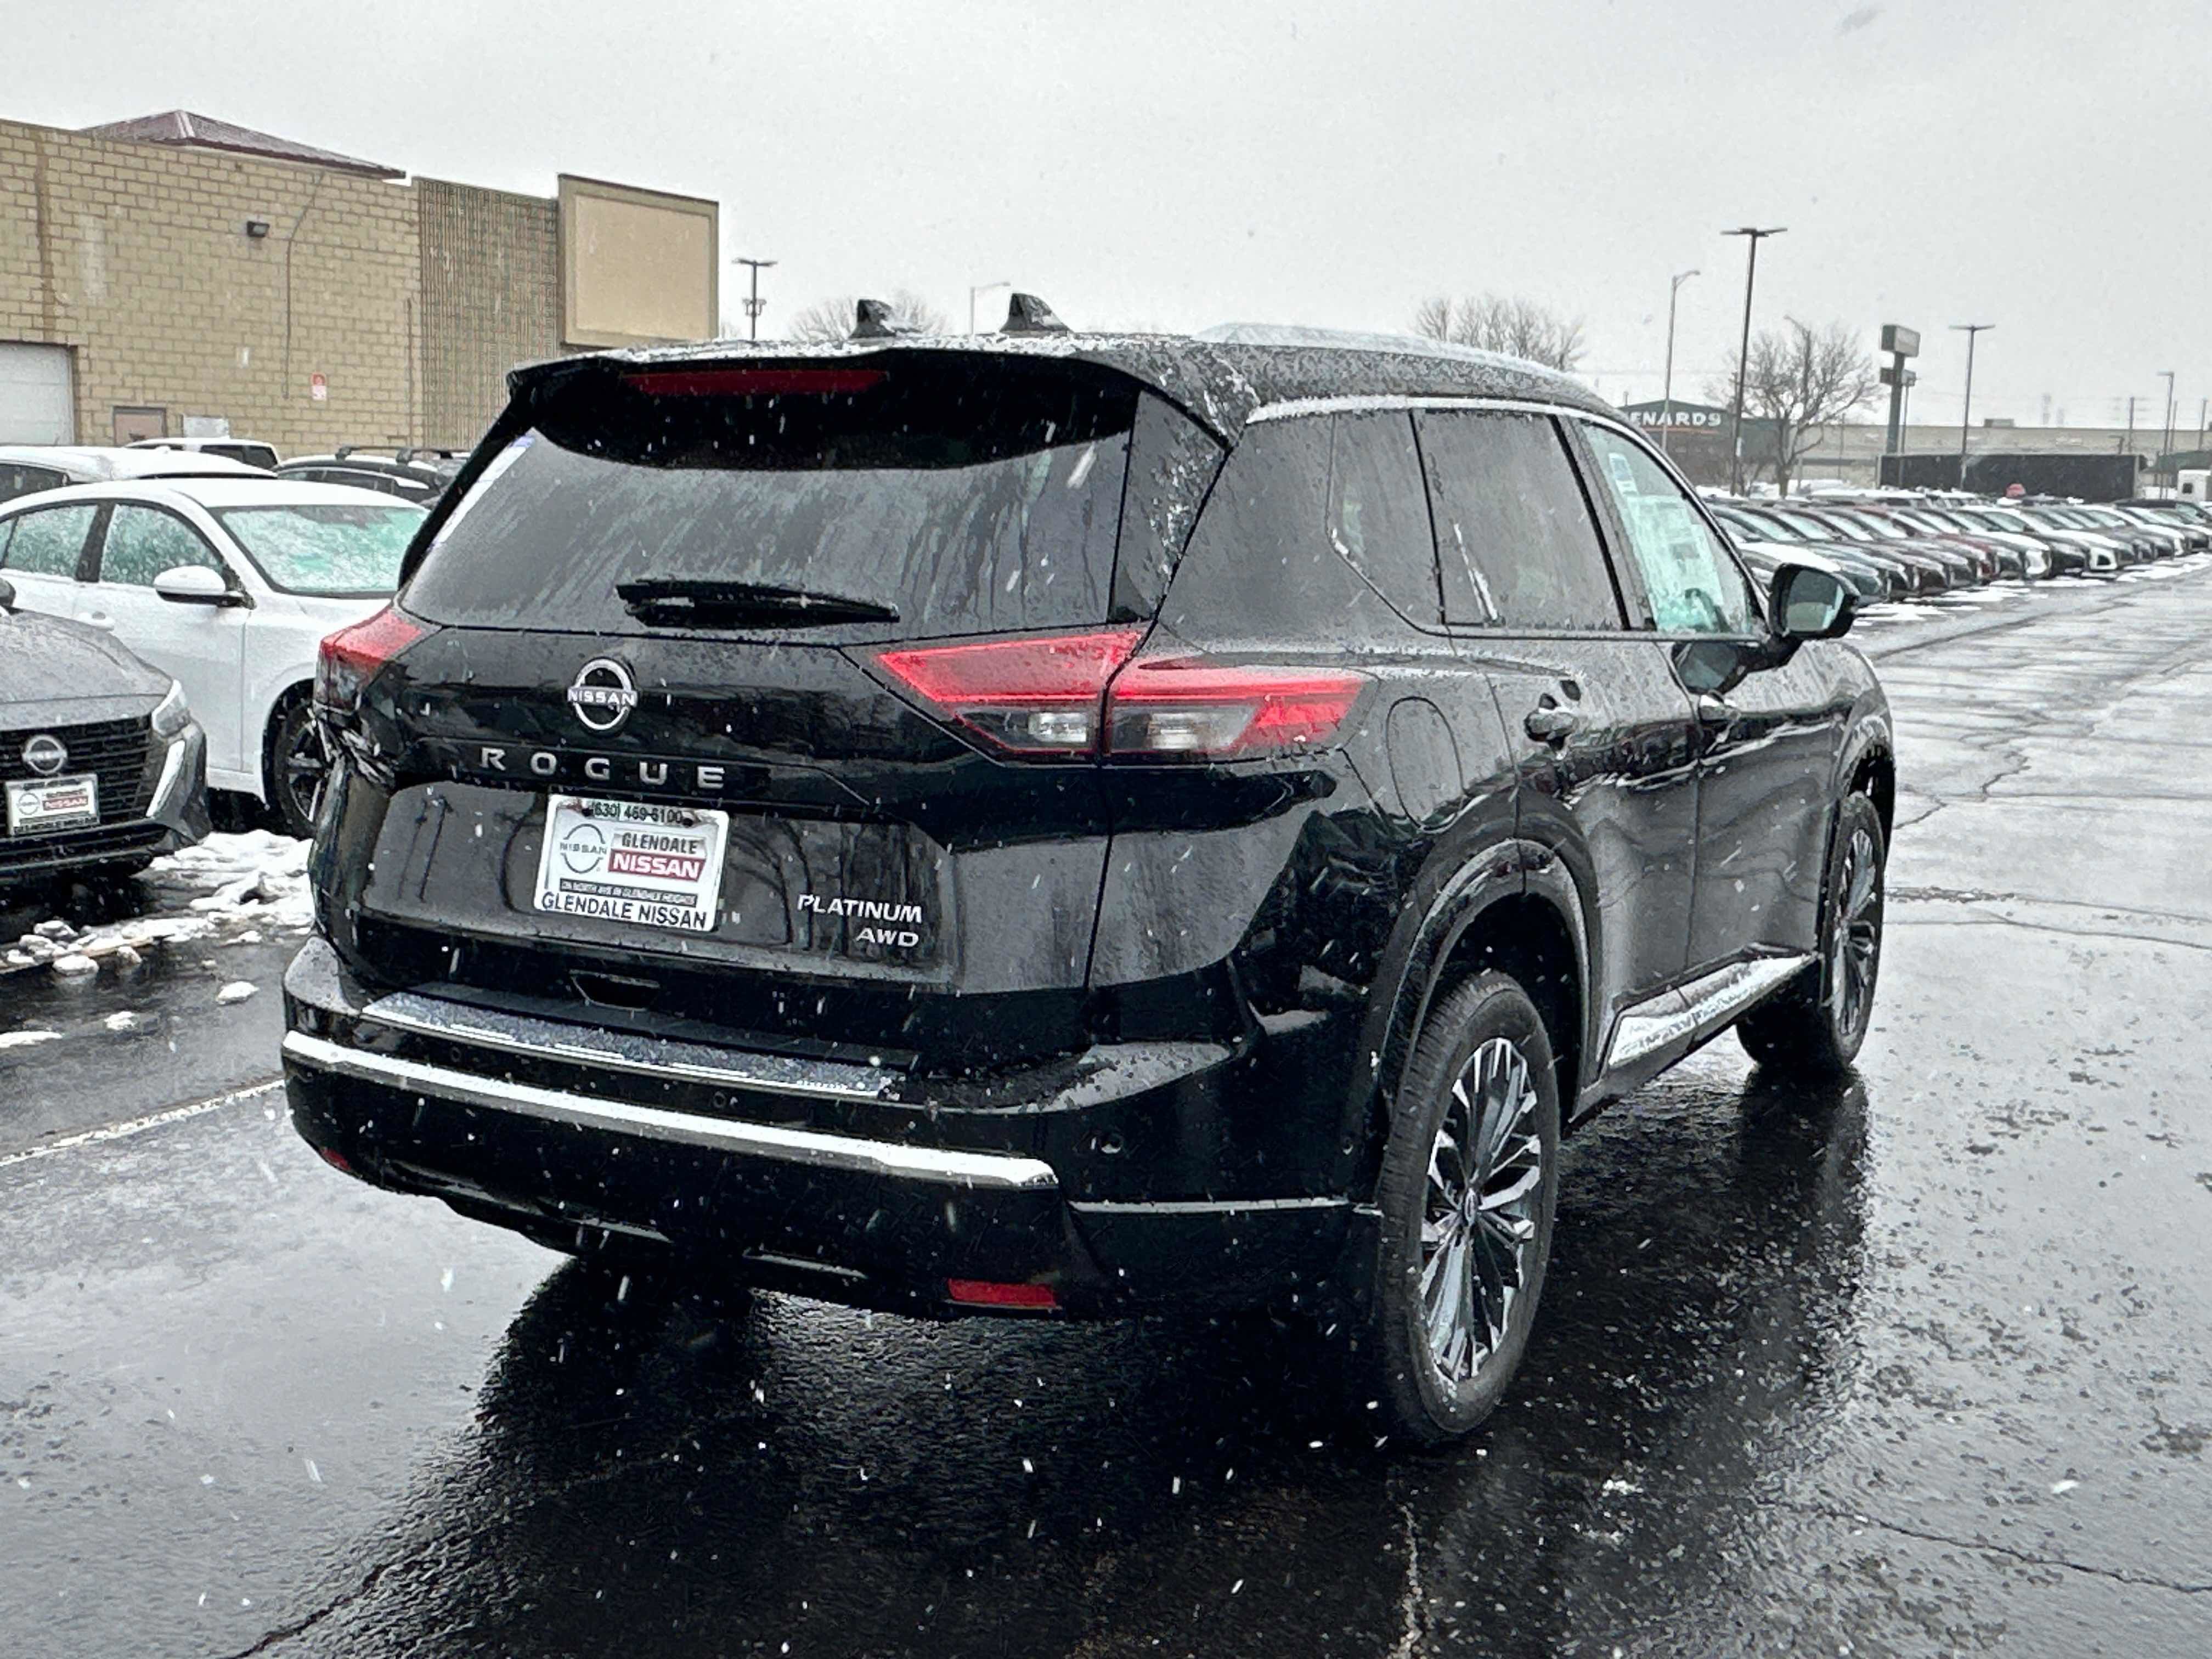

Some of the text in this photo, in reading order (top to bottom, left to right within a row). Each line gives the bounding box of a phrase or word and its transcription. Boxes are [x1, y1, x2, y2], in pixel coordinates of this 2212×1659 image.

[1629, 411, 1721, 427] ENARDS
[568, 688, 635, 706] NISSAN
[479, 747, 725, 789] ROGUE
[622, 832, 698, 855] GLENDALE
[613, 853, 700, 879] NISSAN
[541, 891, 633, 919] GLENDALE
[637, 905, 707, 929] NISSAN
[797, 894, 922, 924] PLATINUM
[855, 927, 919, 947] AWD
